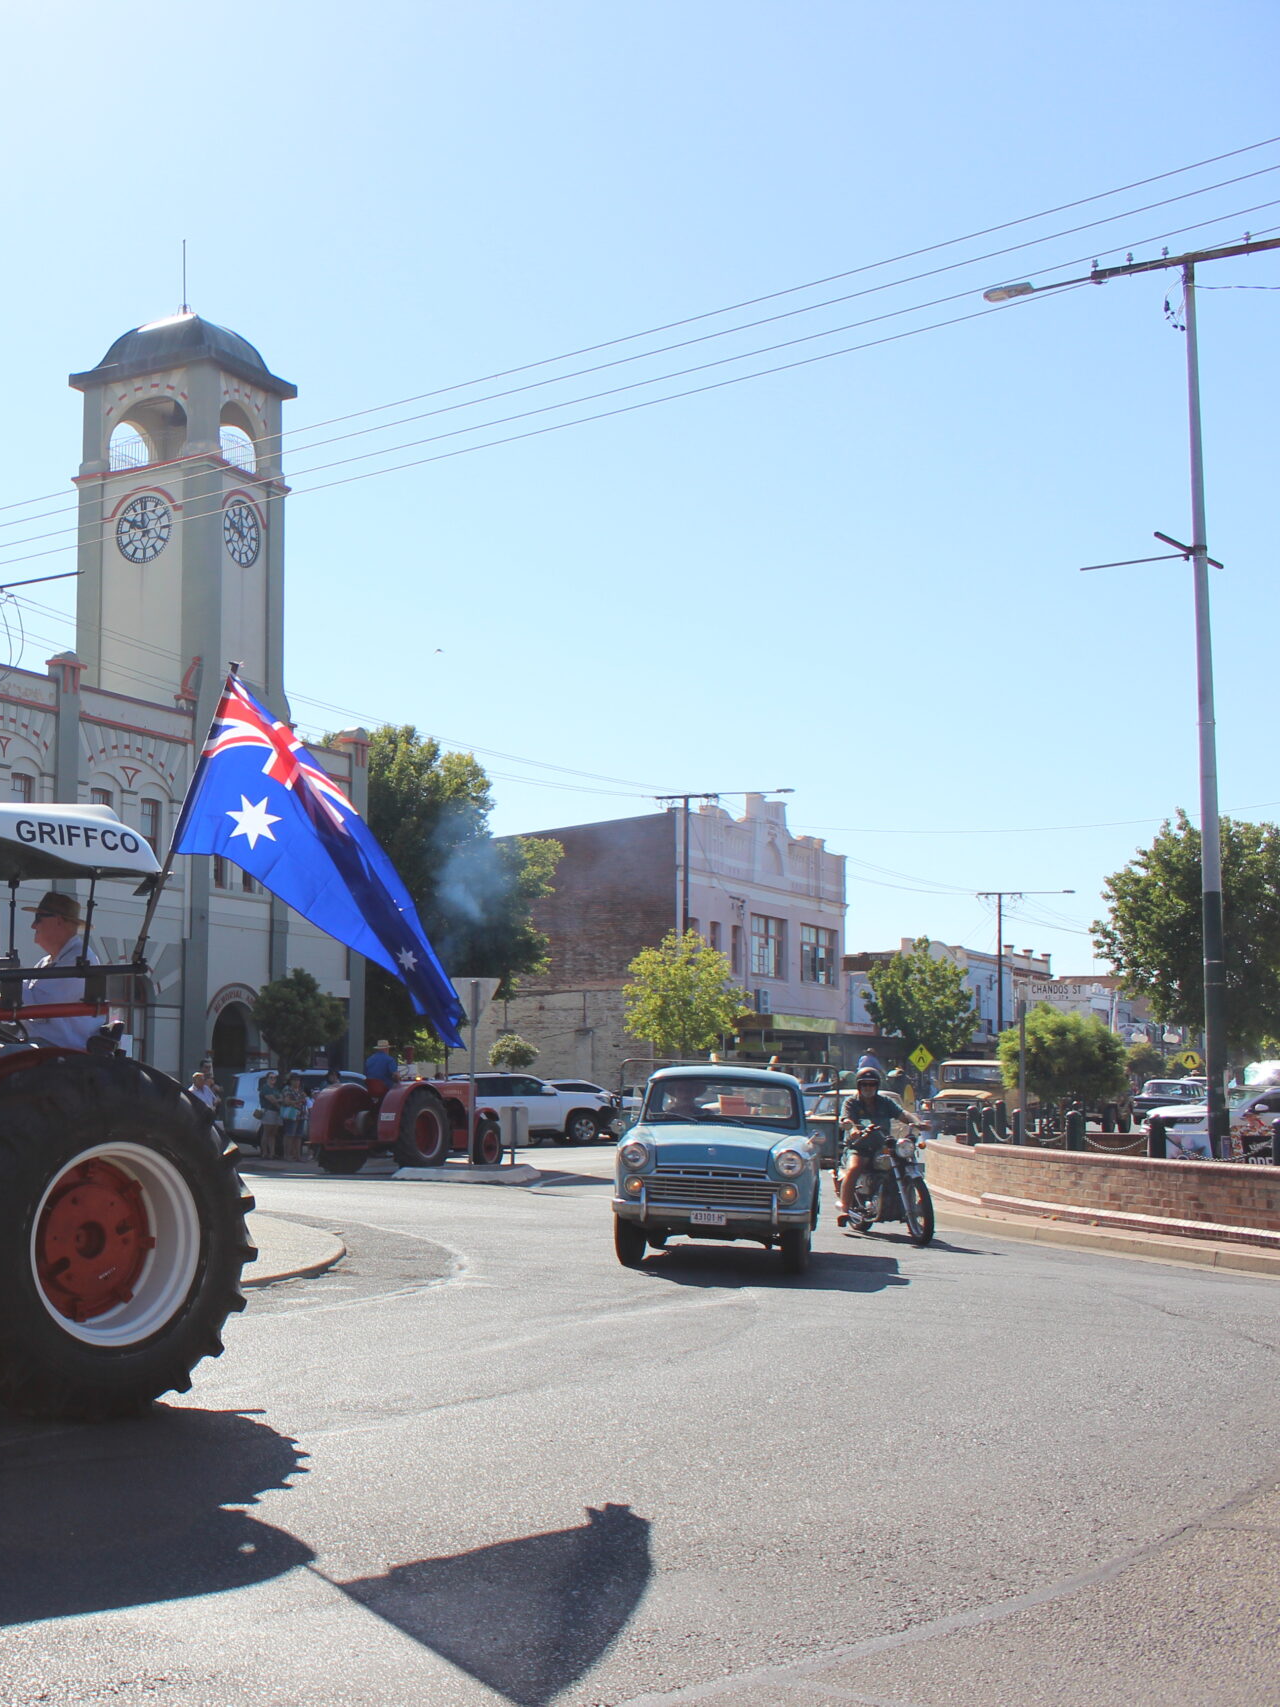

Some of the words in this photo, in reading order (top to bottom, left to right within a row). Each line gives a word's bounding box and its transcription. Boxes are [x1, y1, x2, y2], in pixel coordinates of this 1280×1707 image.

[15, 820, 140, 854] GRIFFCO
[1032, 984, 1069, 995] CHANDOS
[1072, 984, 1082, 995] ST
